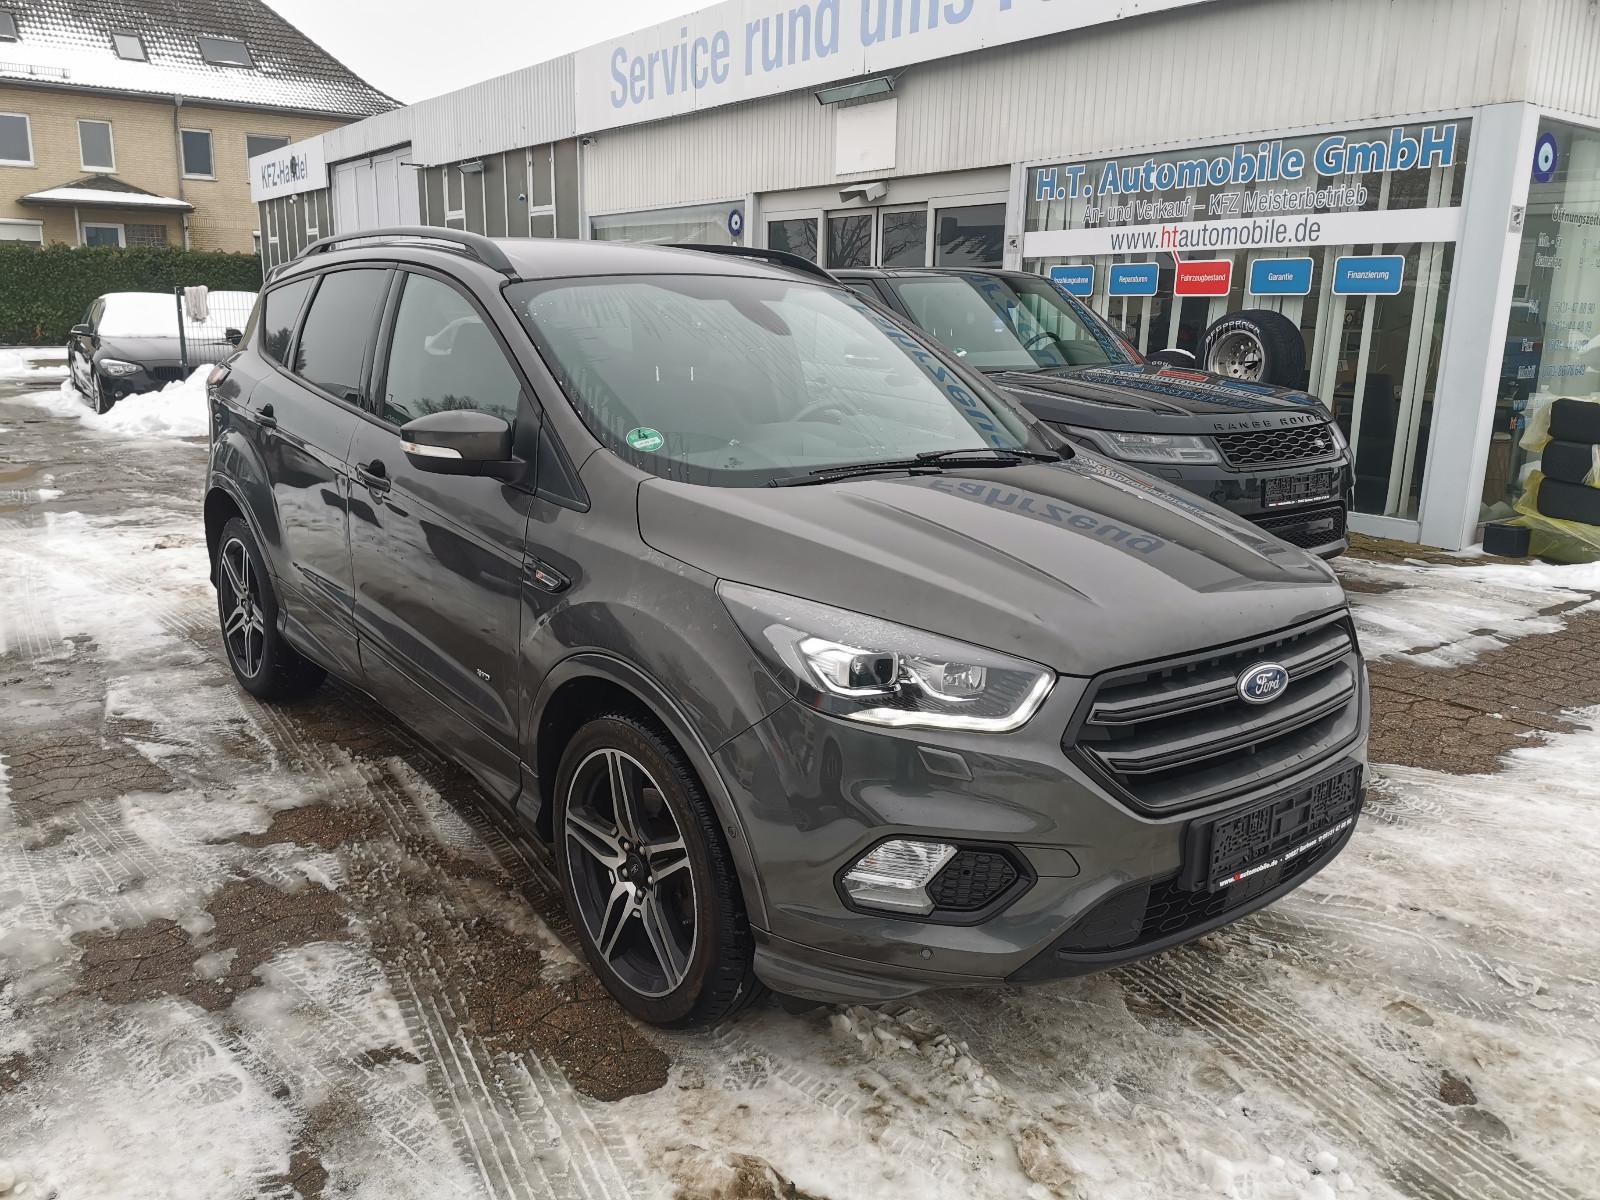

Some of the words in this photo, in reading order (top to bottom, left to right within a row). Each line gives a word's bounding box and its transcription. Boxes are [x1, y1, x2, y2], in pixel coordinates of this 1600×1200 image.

[610, 26, 730, 109] Service
[744, 0, 840, 76] rund
[1035, 164, 1093, 201] H.T.
[1097, 140, 1305, 196] Automobile
[1313, 123, 1458, 177] GmbH
[1082, 207, 1104, 224] An-
[1107, 201, 1134, 221] und
[1136, 196, 1192, 220] Verkauf
[1208, 192, 1241, 216] KFZ
[1242, 183, 1368, 213] Meisterbetrieb
[1110, 217, 1322, 250] www.htautomobile.de
[1180, 273, 1226, 283] Fahrzeugbestand
[1268, 271, 1294, 282] Garantie
[1347, 269, 1390, 281] Finanzierung
[1213, 419, 1272, 431] RANGE
[1279, 414, 1323, 426] ROVER
[1255, 671, 1281, 695] Ford
